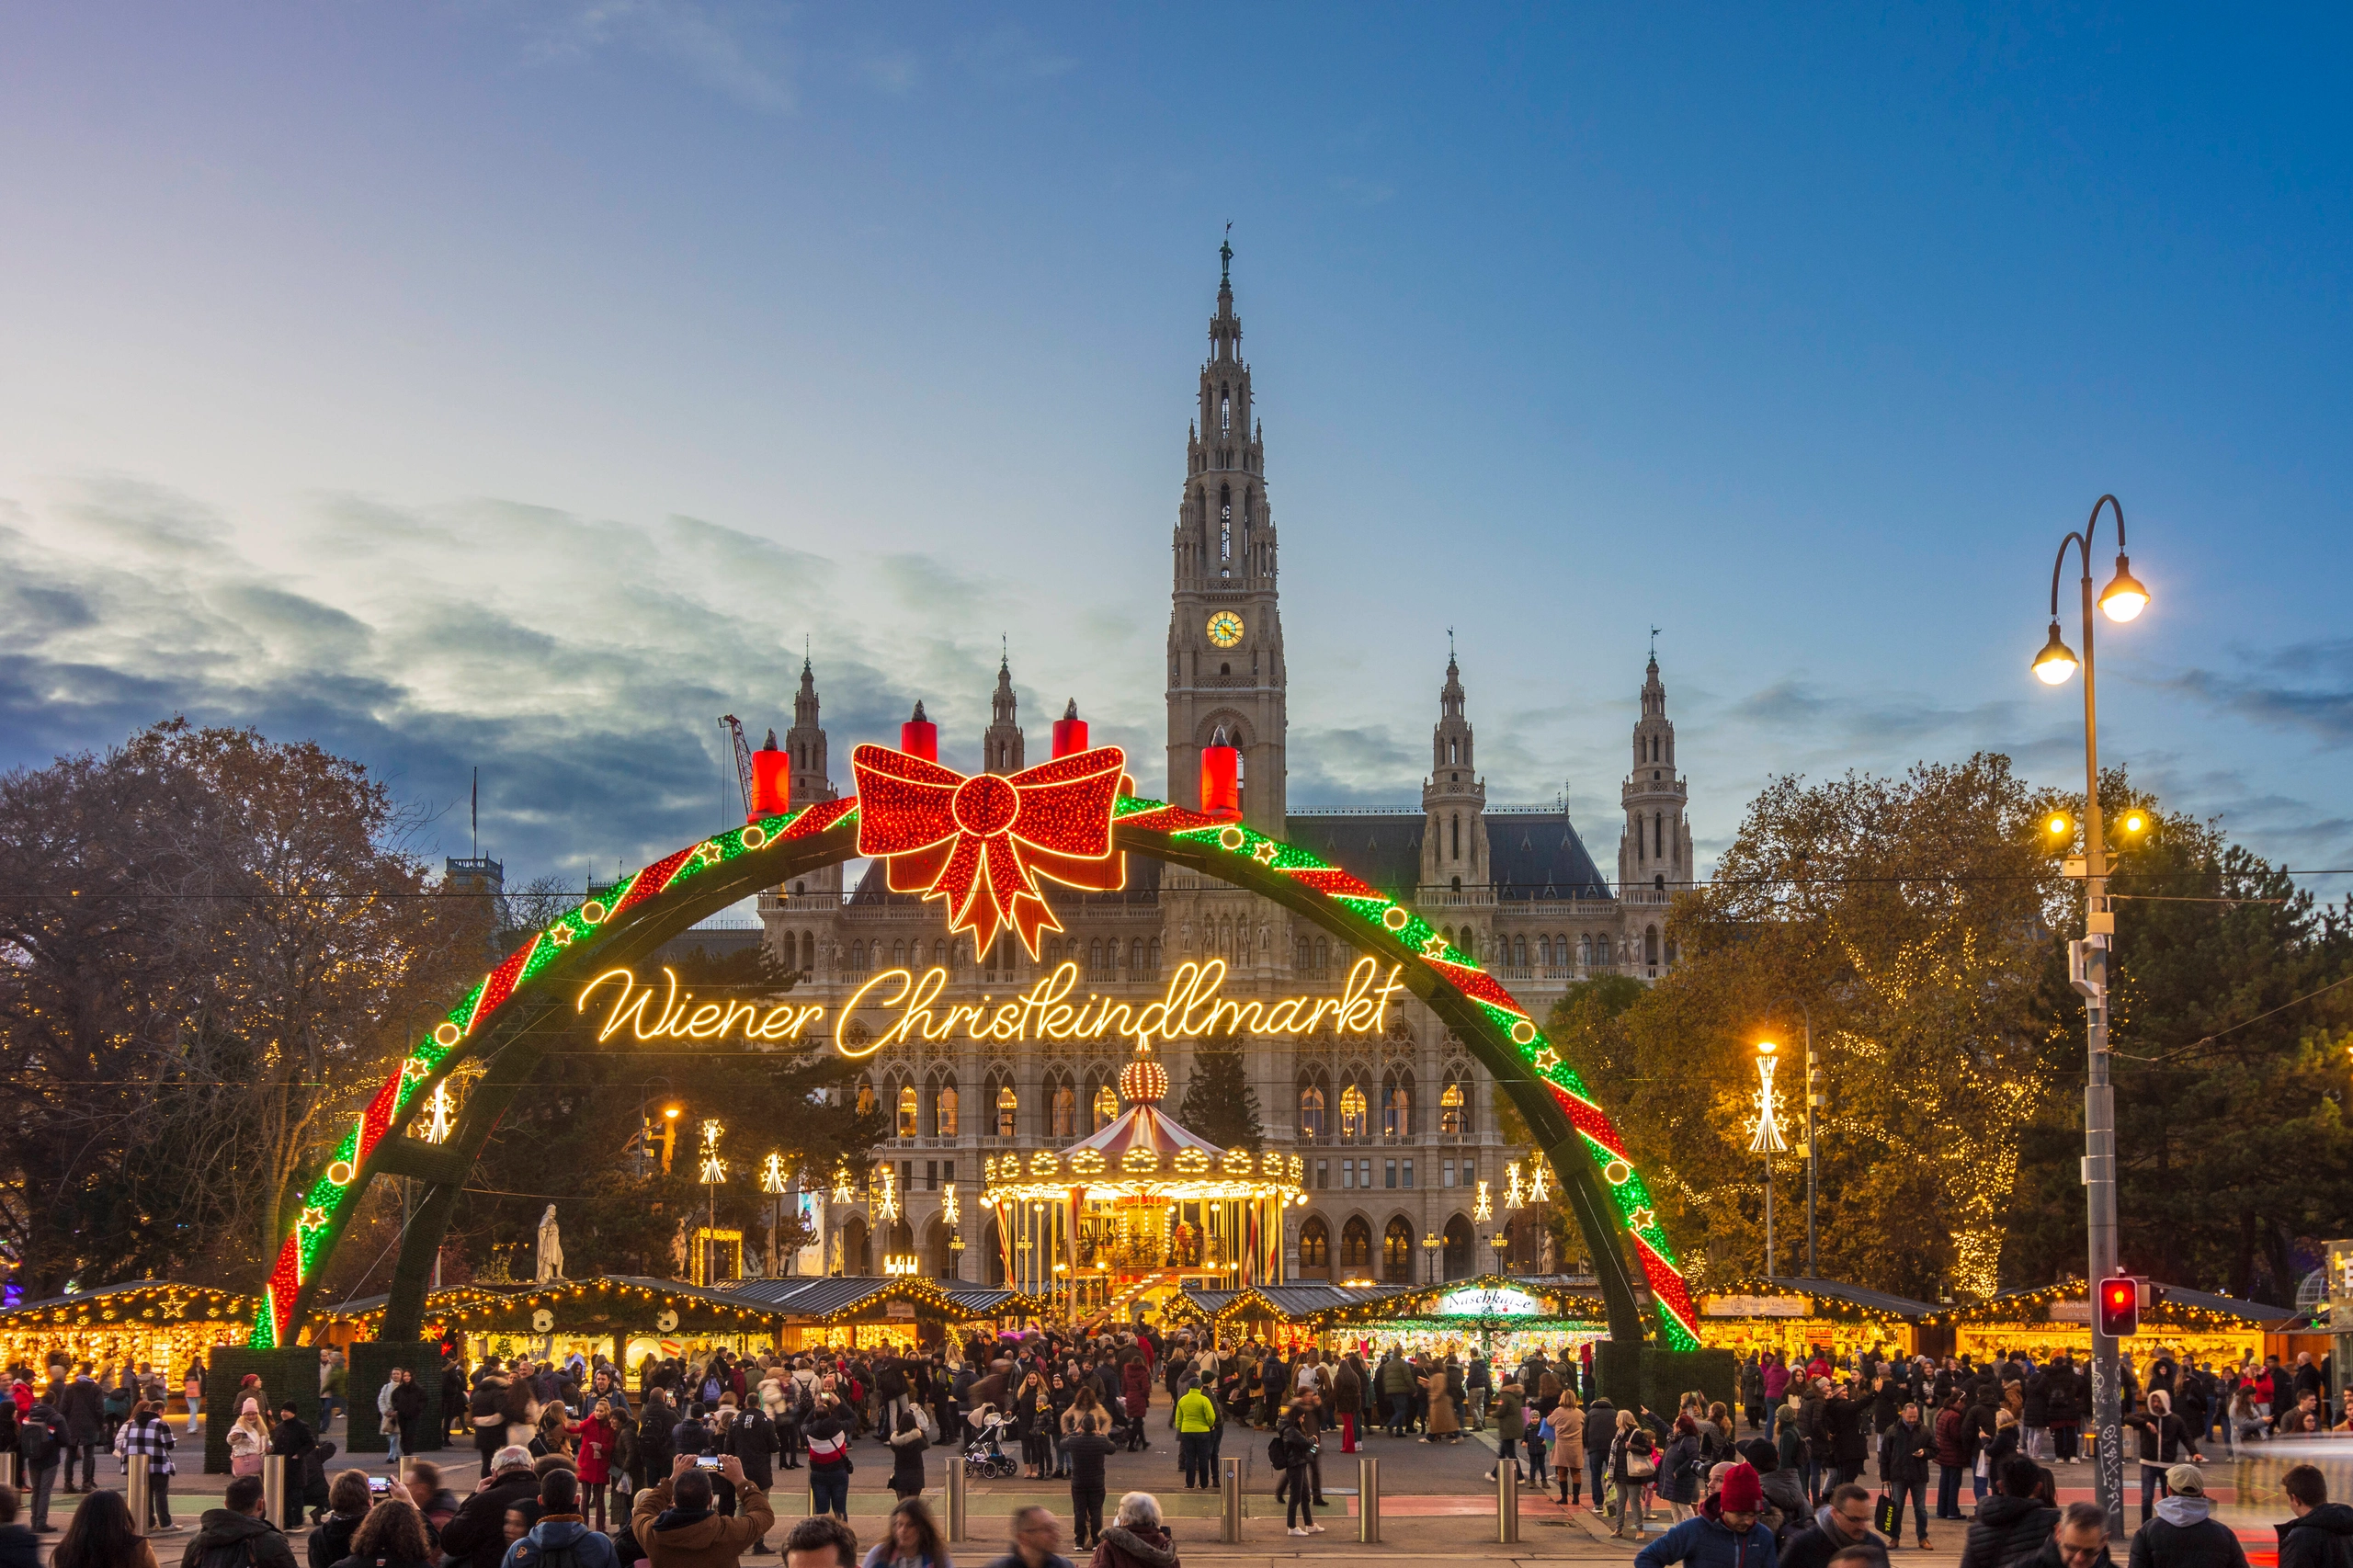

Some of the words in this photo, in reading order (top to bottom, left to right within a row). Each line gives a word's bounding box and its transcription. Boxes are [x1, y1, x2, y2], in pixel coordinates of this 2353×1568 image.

[577, 966, 824, 1042] Wiener
[835, 956, 1405, 1059] Christkindlmarkt
[1449, 1290, 1531, 1309] Naschkatze
[2052, 1301, 2090, 1310] Holzschnit
